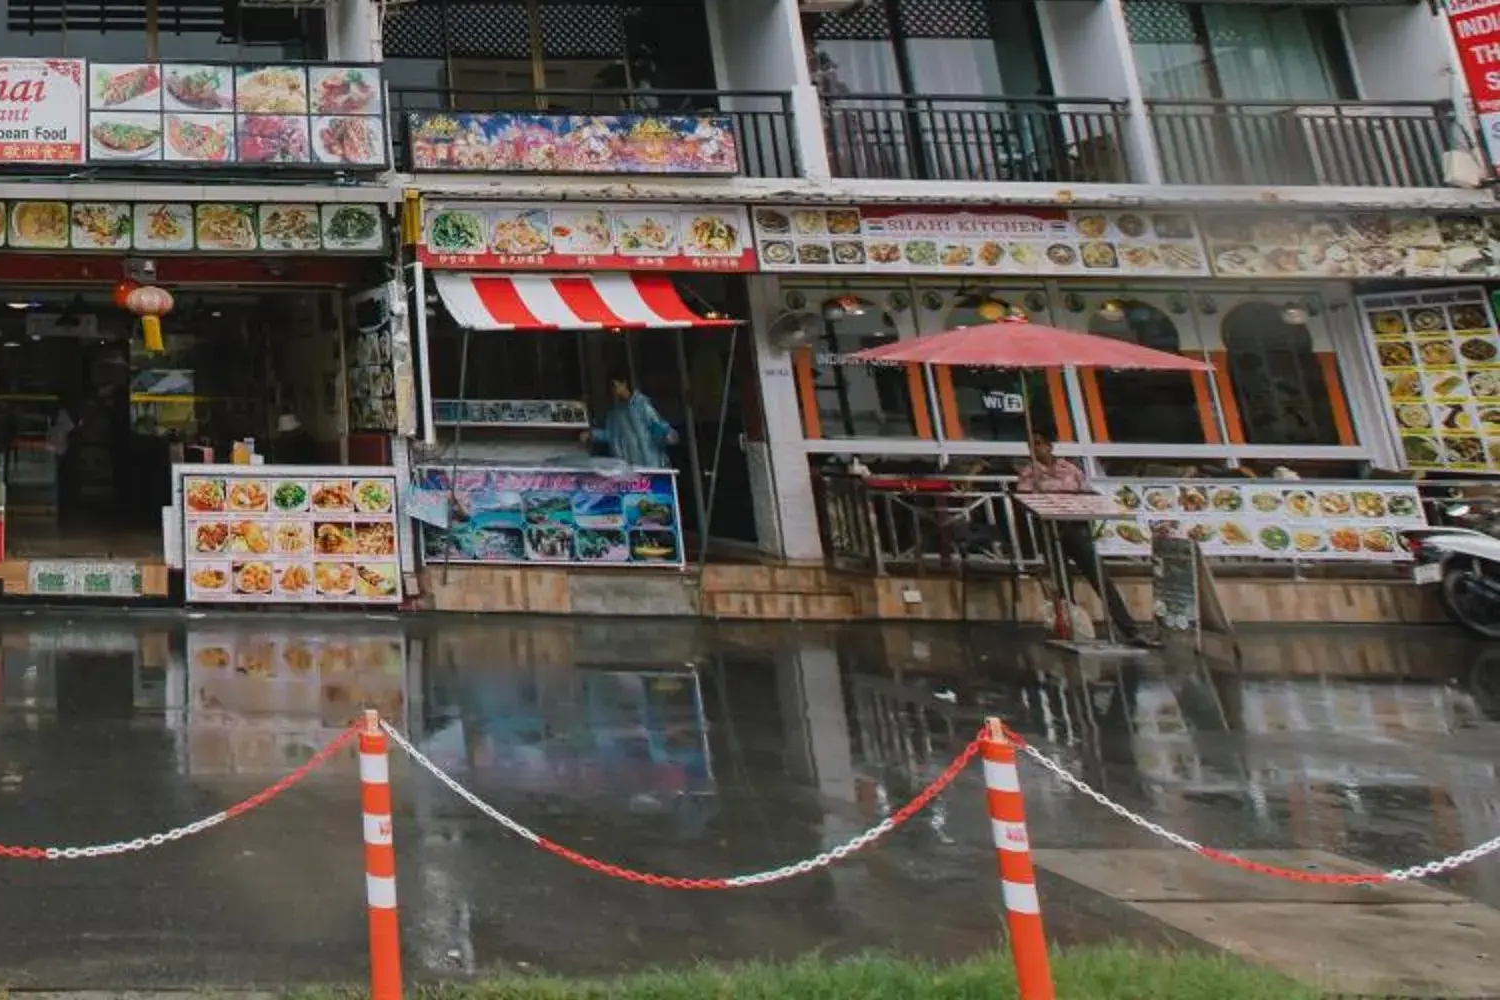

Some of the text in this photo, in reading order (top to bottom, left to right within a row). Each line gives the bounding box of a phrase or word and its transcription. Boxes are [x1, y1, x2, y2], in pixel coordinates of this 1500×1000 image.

[1456, 12, 1500, 38] INDI
[35, 126, 67, 140] Food
[956, 220, 1045, 233] KITCHEN
